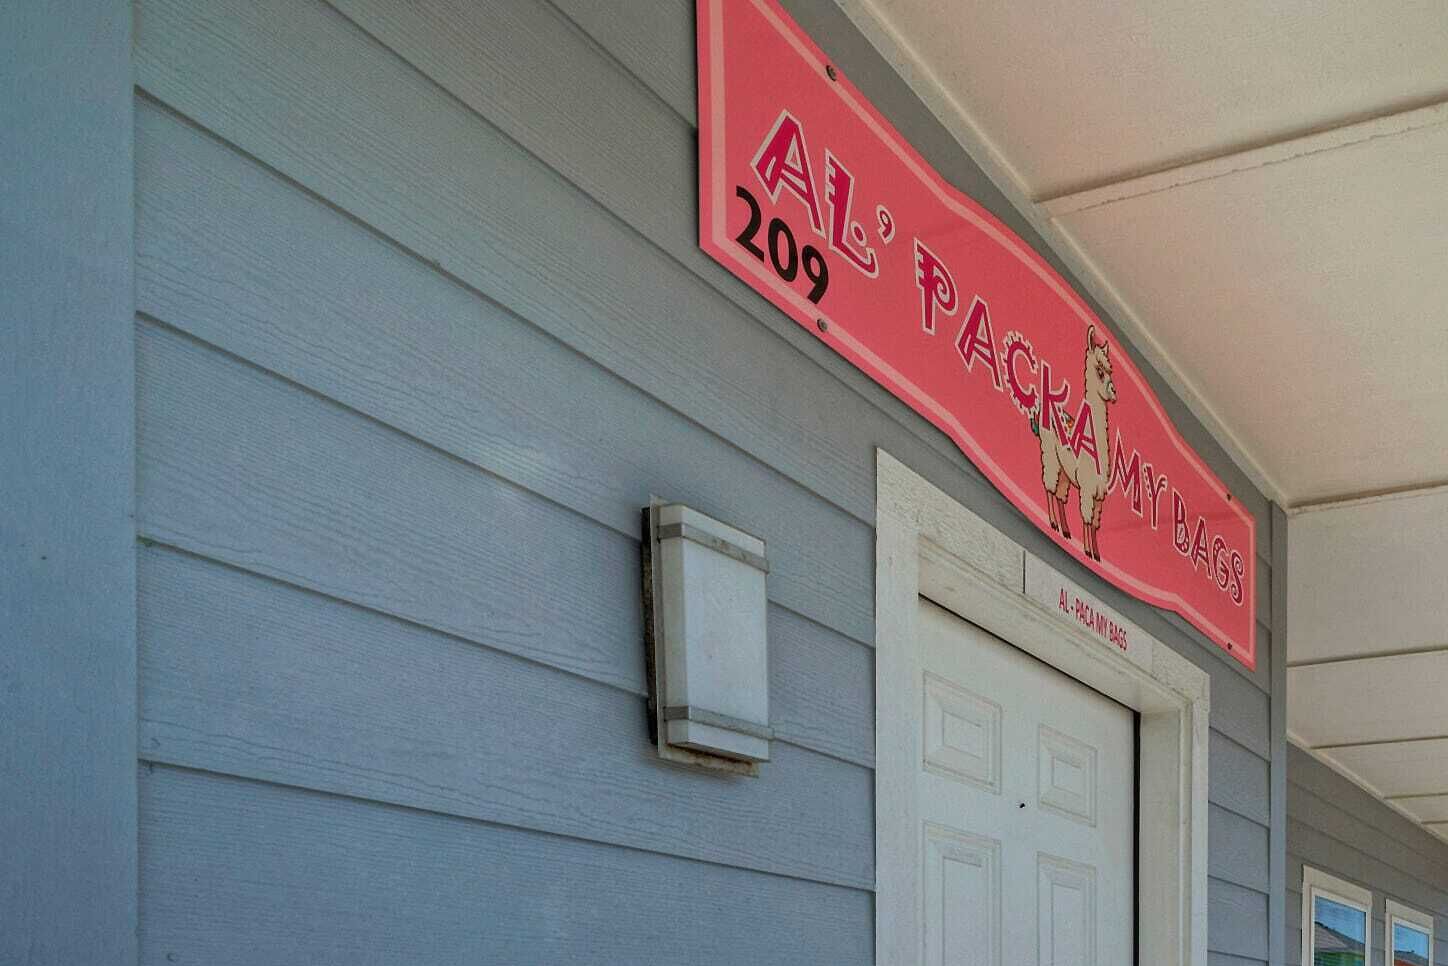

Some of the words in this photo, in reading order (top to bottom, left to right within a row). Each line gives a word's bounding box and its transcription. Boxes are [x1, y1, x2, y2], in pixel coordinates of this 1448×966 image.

[735, 185, 829, 304] 209
[1107, 427, 1168, 530] MY
[1172, 487, 1244, 606] BAGS
[1109, 621, 1127, 651] BAGS
